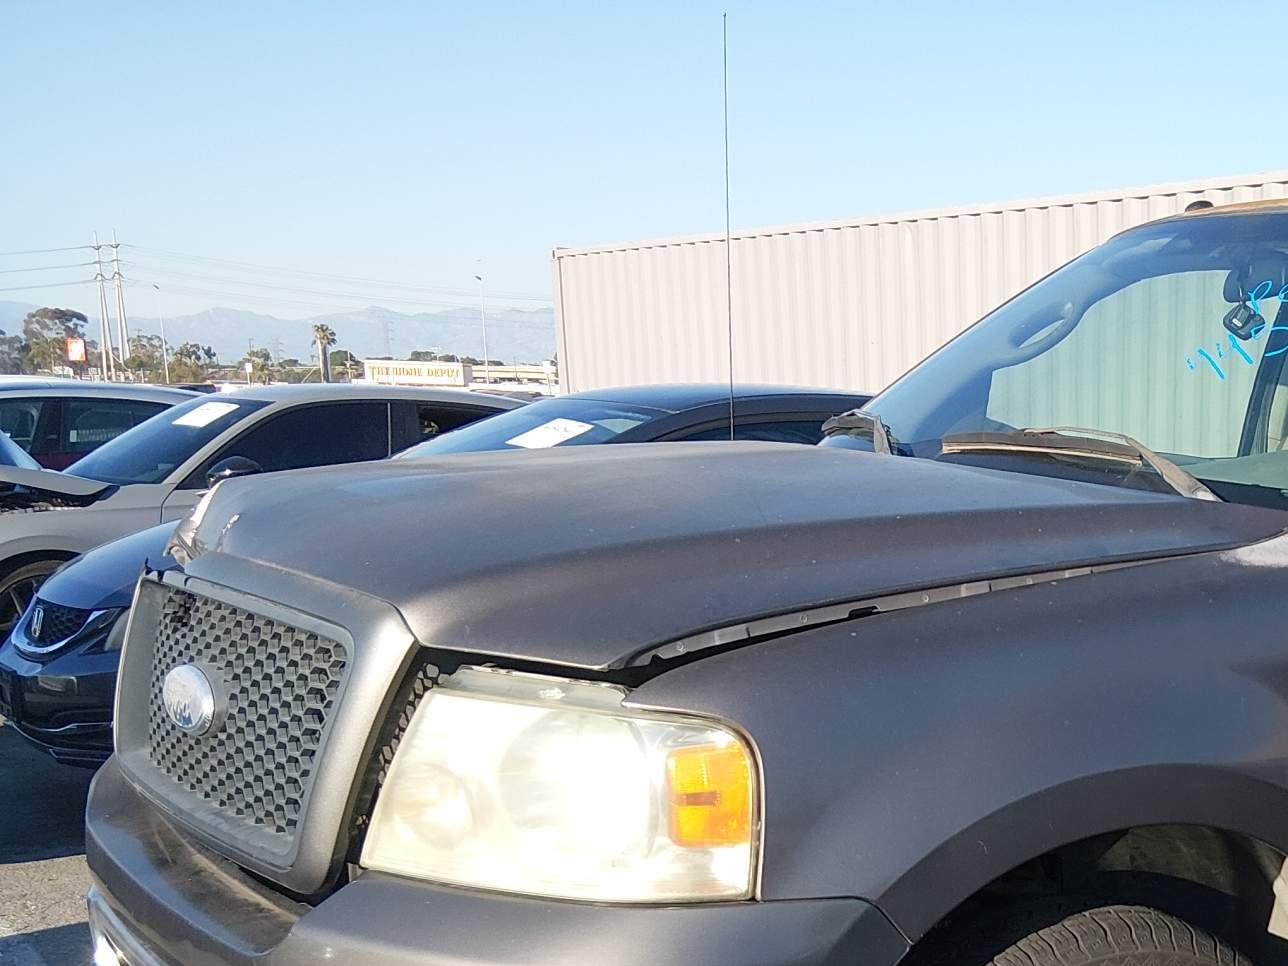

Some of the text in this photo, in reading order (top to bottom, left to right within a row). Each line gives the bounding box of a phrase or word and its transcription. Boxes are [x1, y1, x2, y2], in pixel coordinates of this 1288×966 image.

[369, 366, 459, 380] THE HOME DEPOT
